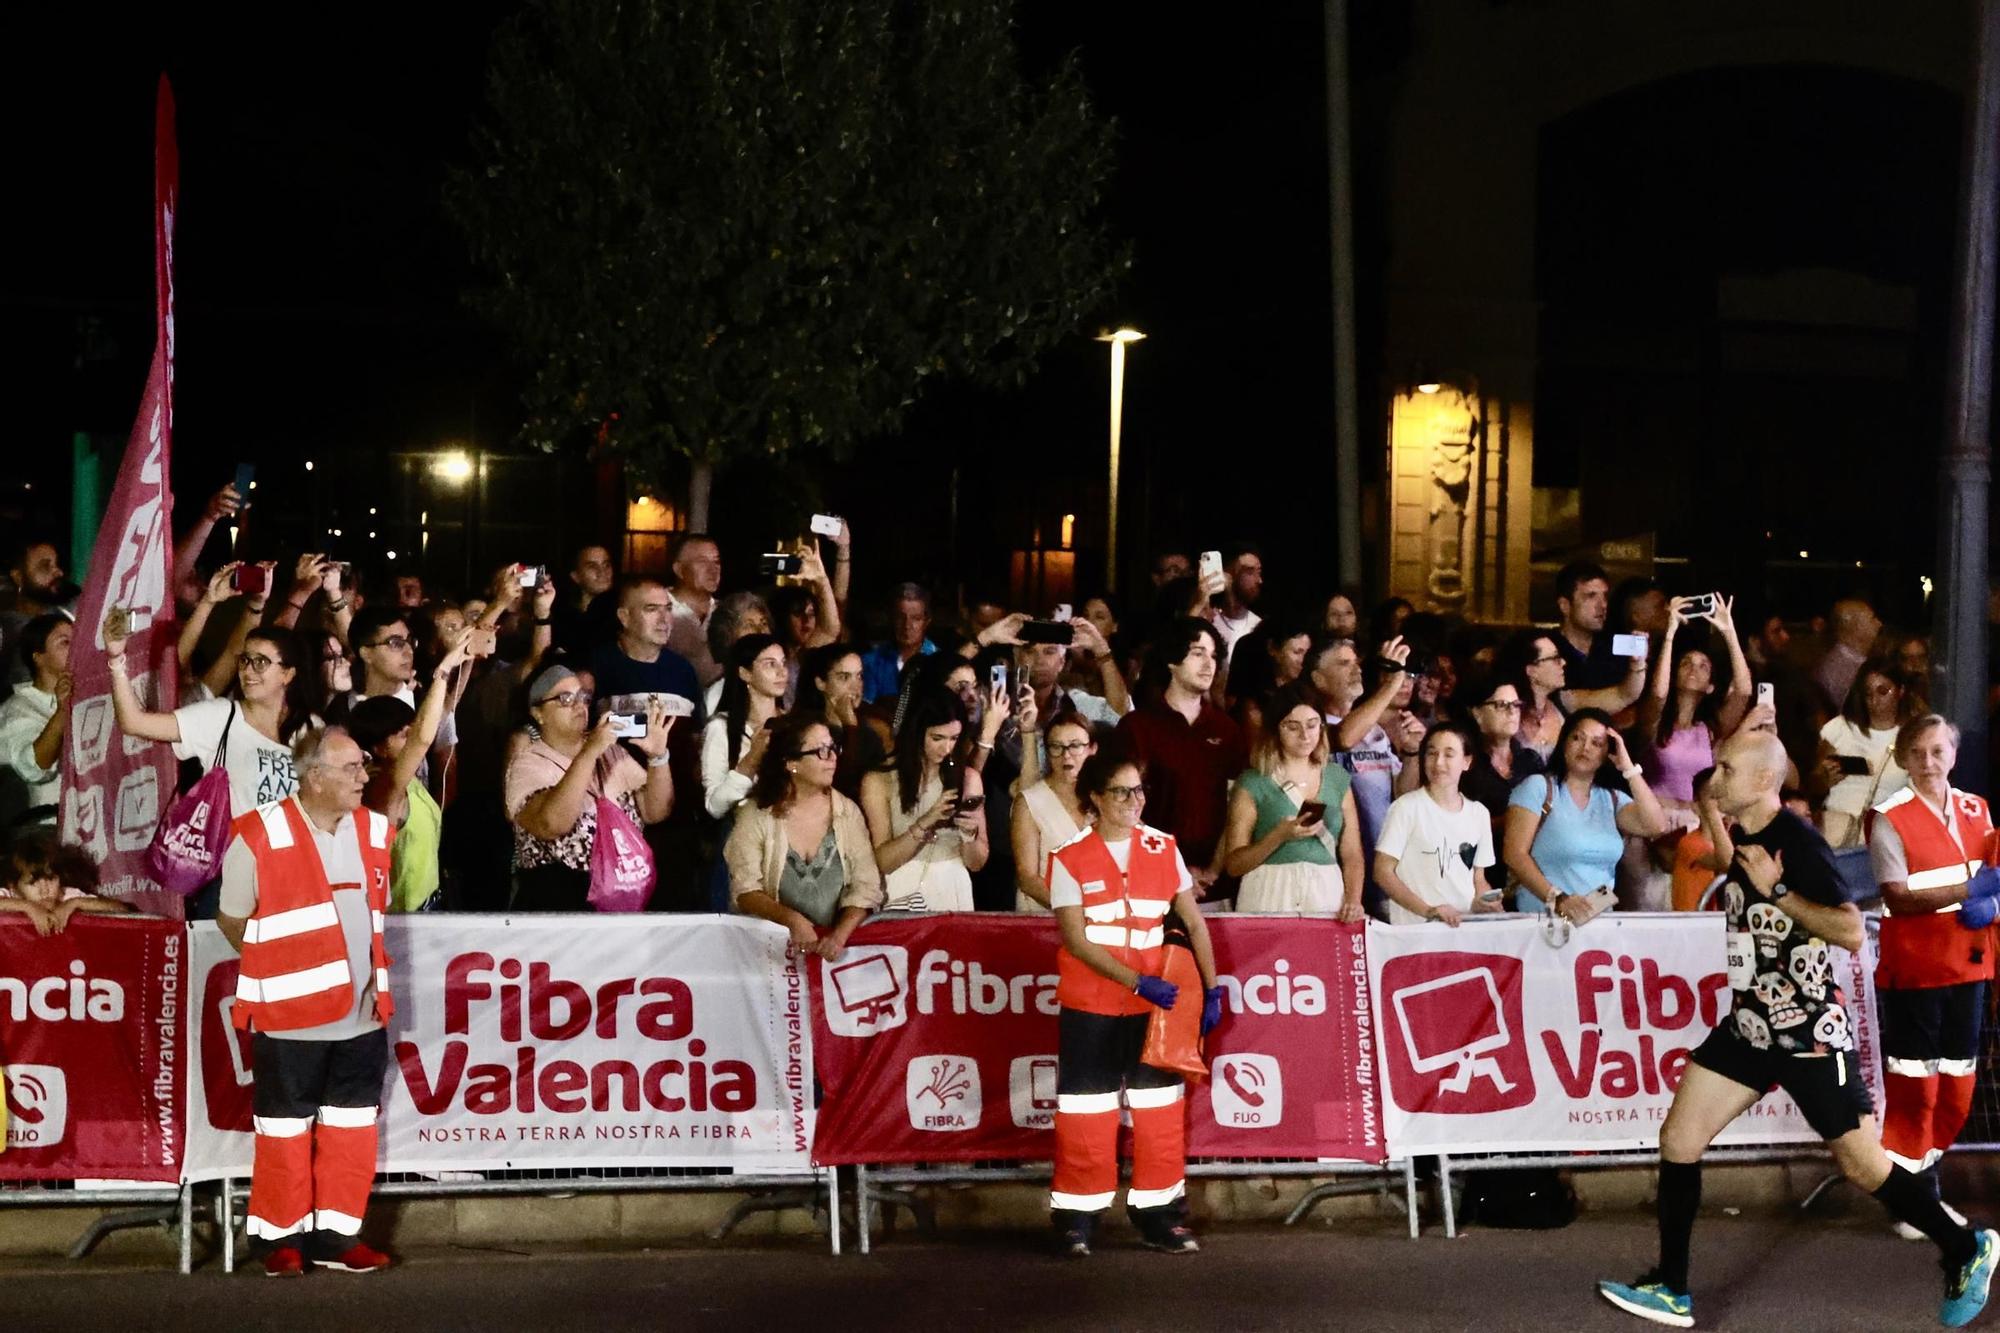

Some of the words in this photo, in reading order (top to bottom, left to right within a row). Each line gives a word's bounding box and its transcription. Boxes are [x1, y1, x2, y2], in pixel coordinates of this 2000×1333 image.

[257, 747, 293, 761] BREA
[259, 757, 298, 780] FRE
[444, 951, 694, 1042] fibra
[1575, 950, 1728, 1030] fibr
[154, 935, 180, 1166] www.fibravalencia.es
[1351, 933, 1379, 1147] www.fibravalencia.es
[394, 1038, 757, 1115] Valencia
[1541, 1030, 1692, 1098] Vale
[419, 1127, 506, 1142] NOSTRA
[517, 1126, 585, 1140] TERRA
[596, 1125, 680, 1139] NOSTRA
[690, 1125, 751, 1139] FIBRA
[925, 1115, 965, 1127] FIBRA
[1234, 1113, 1261, 1124] FIJO
[1568, 1110, 1639, 1124] NOSTRA
